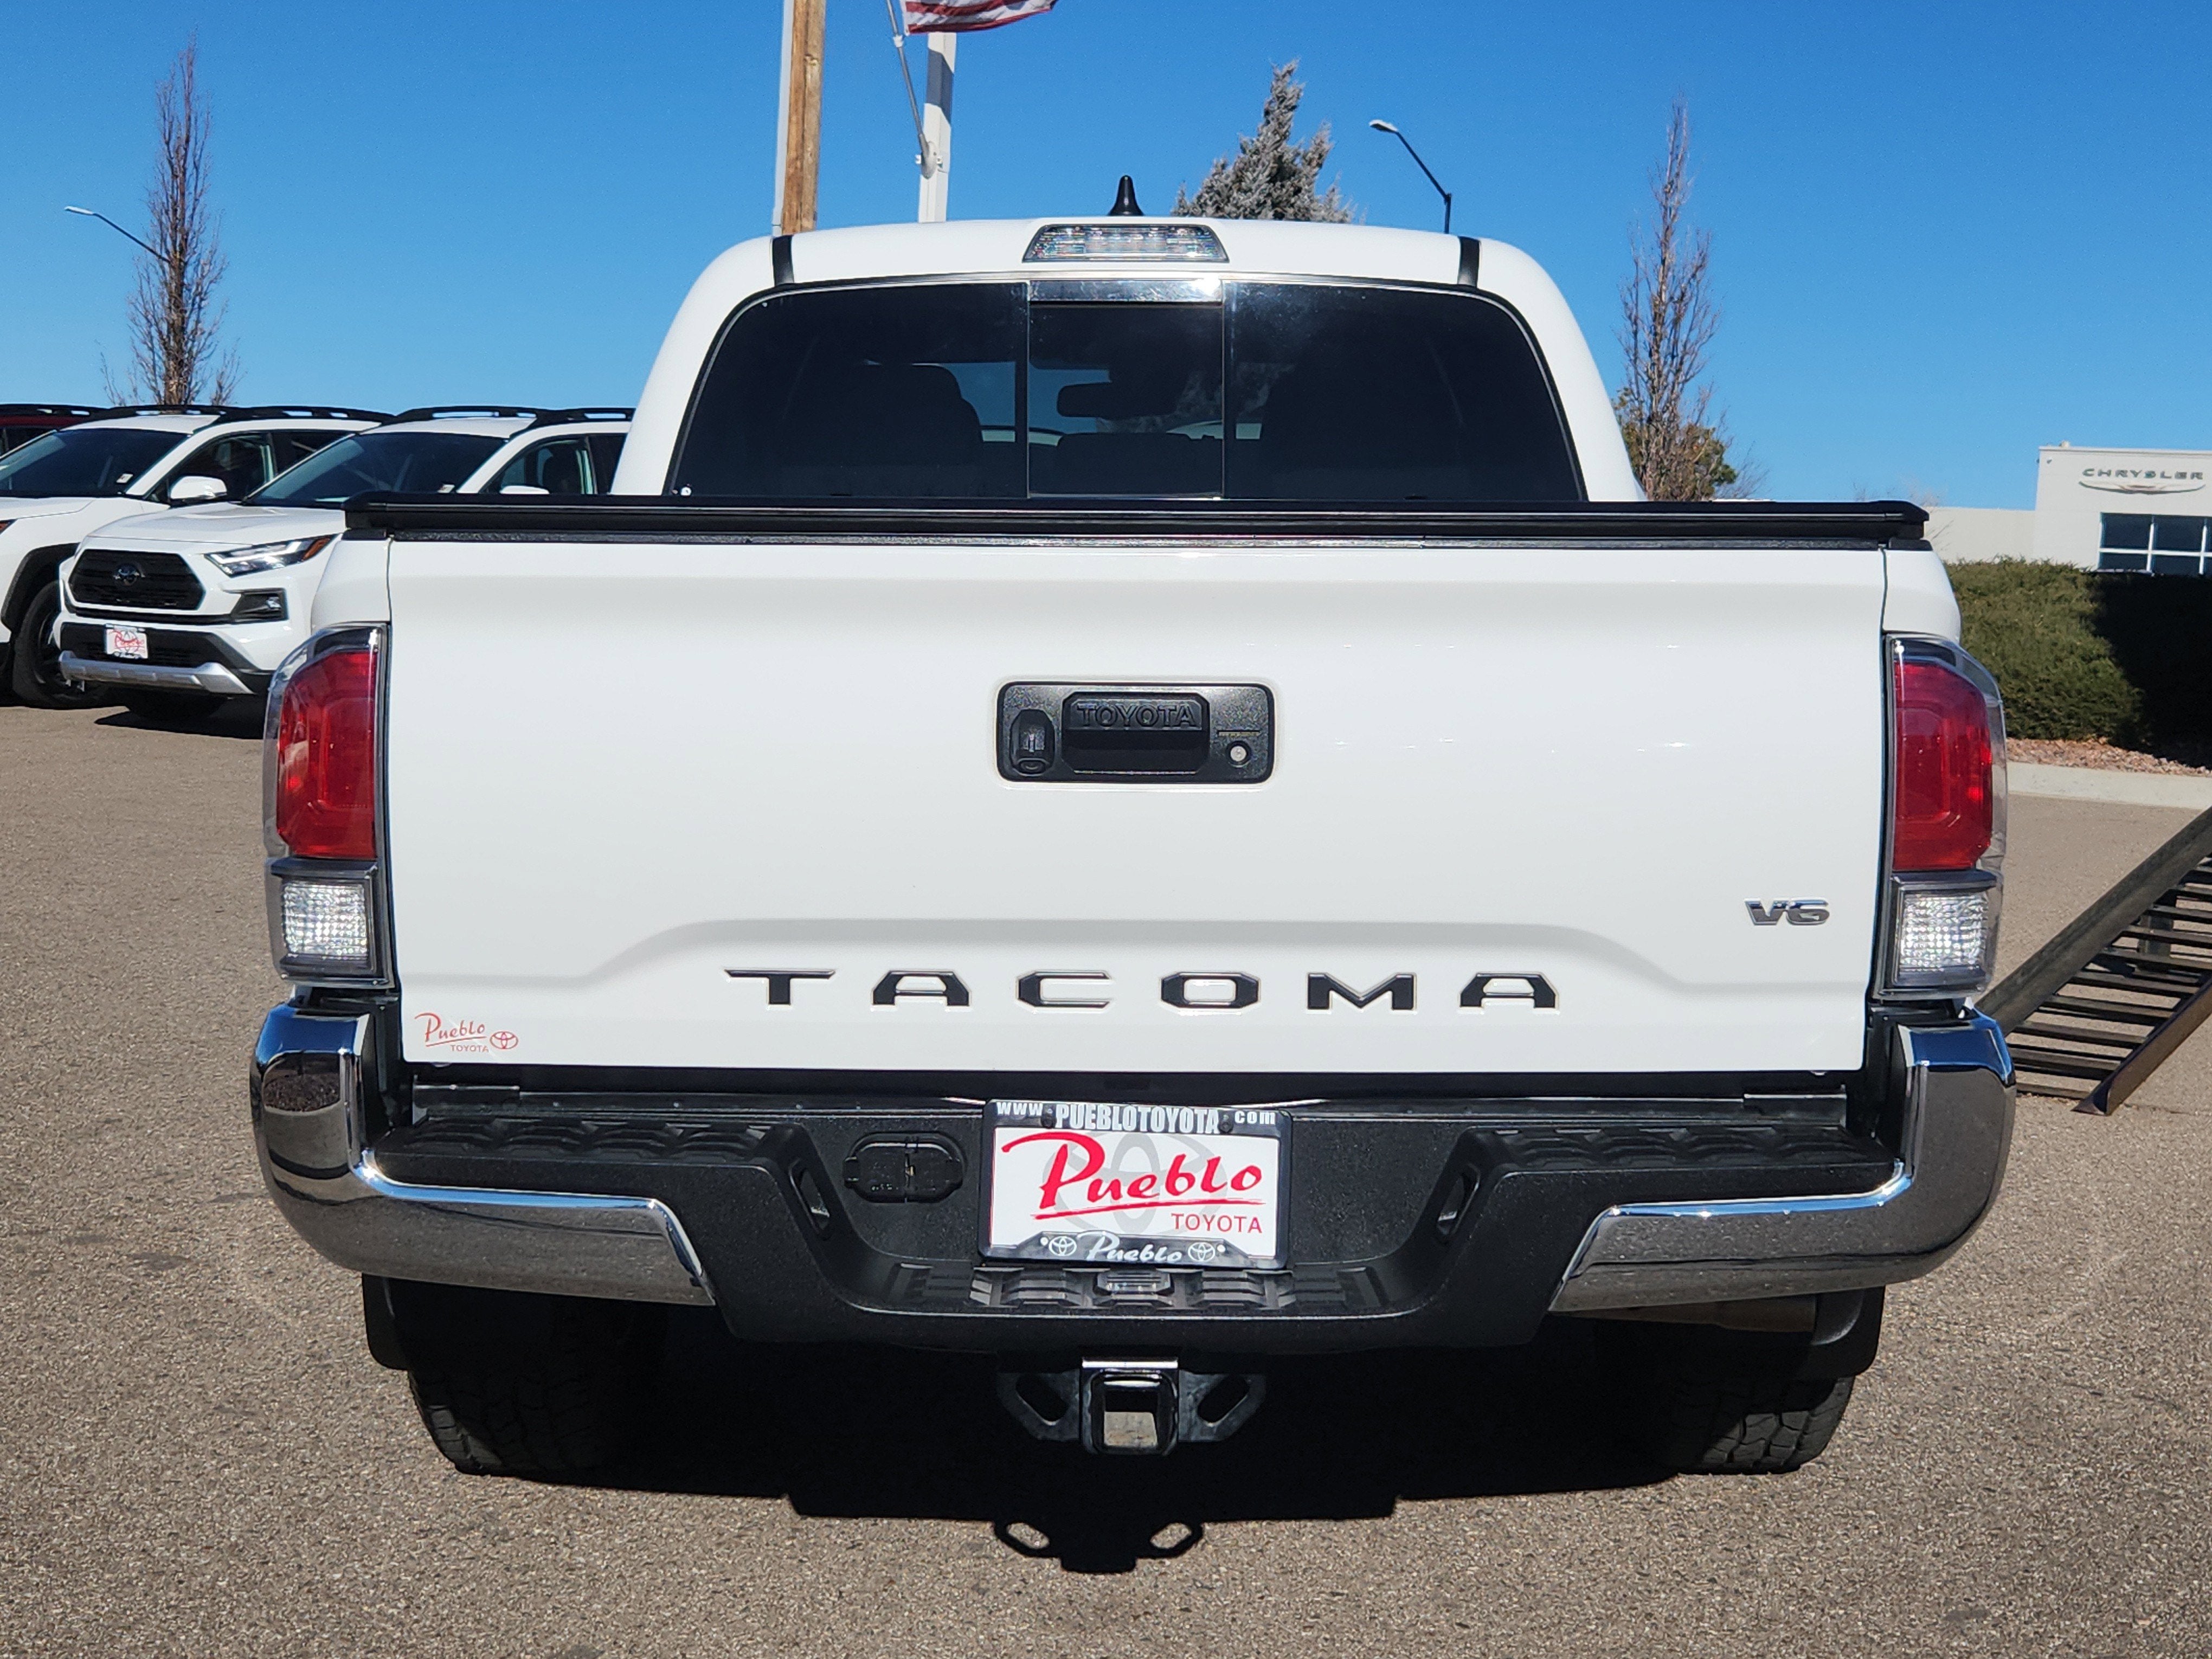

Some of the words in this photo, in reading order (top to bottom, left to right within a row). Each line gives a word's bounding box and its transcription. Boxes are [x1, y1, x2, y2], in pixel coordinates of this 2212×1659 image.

[1077, 704, 1198, 728] TOYOTA
[1744, 899, 1830, 926] V6
[724, 969, 1558, 1009] TACOMA
[414, 1012, 486, 1043] Pueblo
[450, 1044, 489, 1053] TOYOTA
[1001, 1131, 1263, 1210] Pueblo
[1171, 1212, 1263, 1233] TOYOTA
[1076, 1230, 1184, 1264] Pueblo
